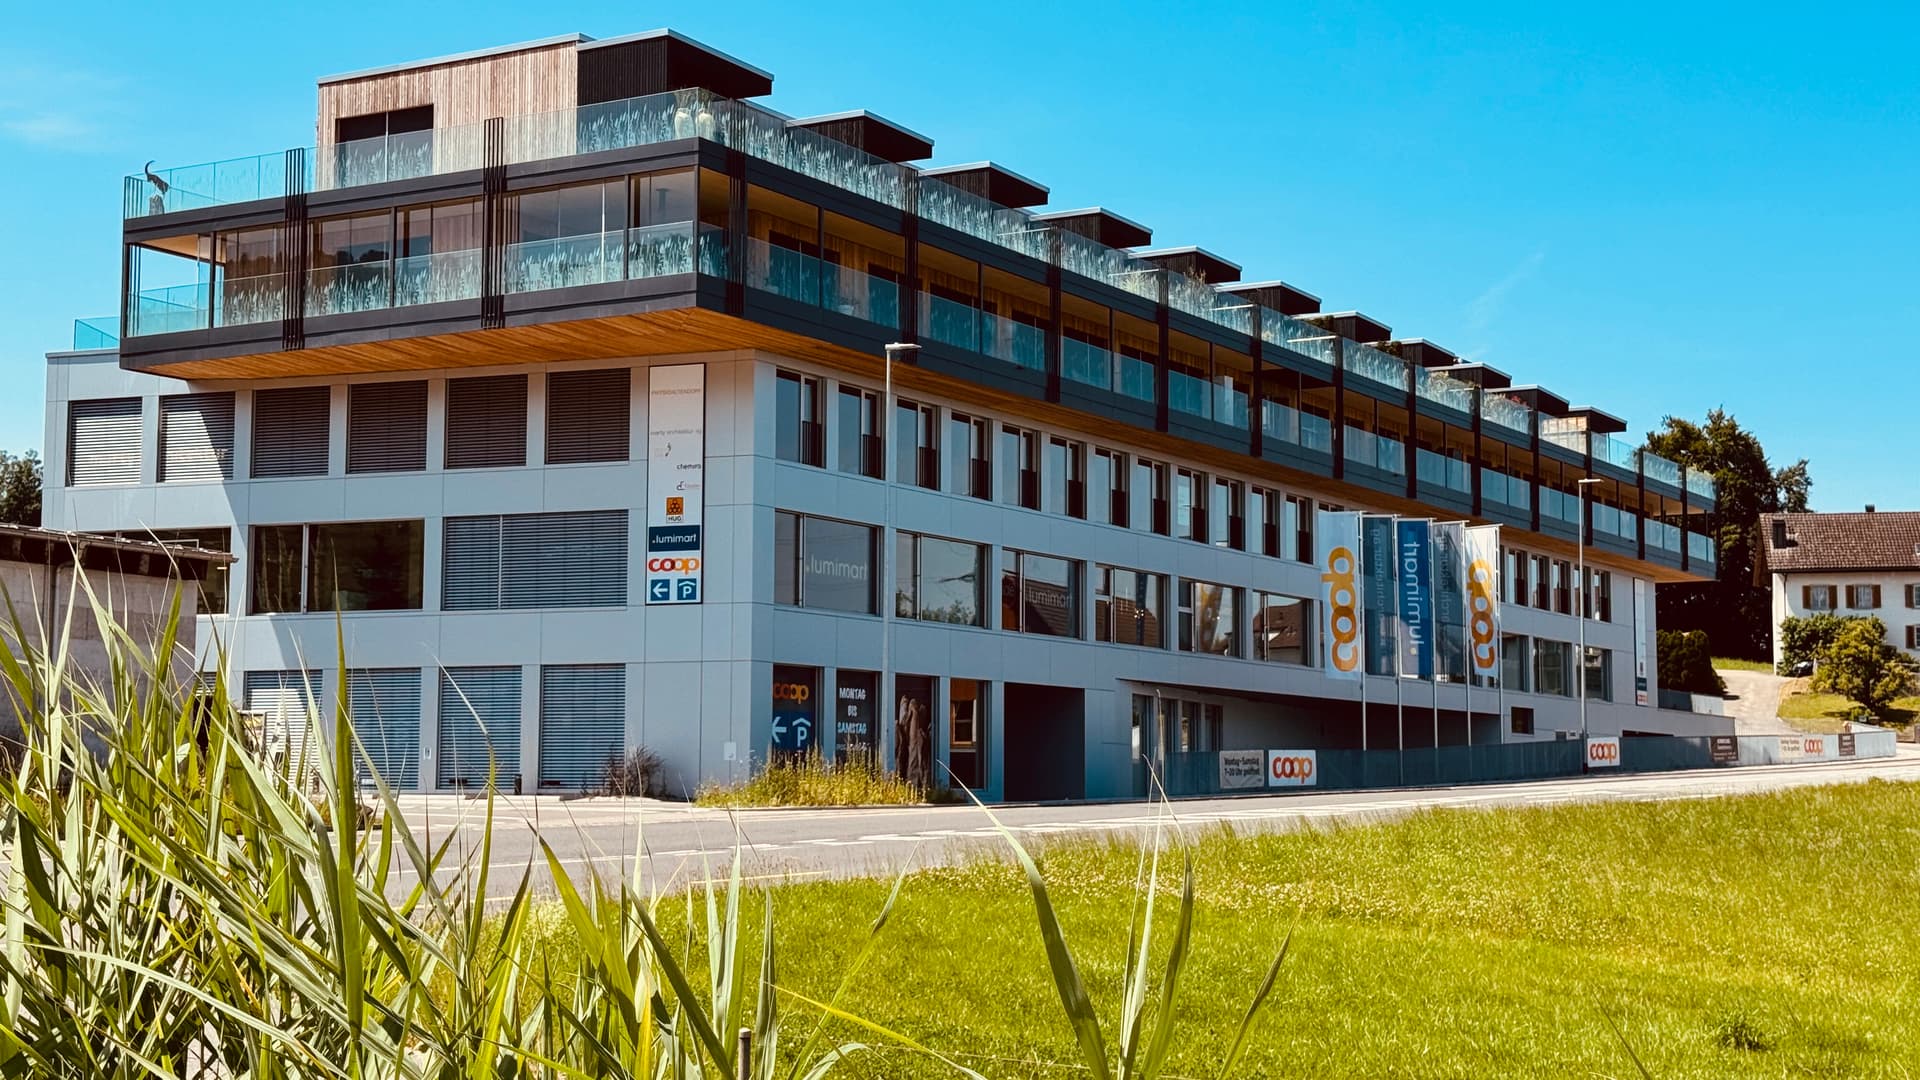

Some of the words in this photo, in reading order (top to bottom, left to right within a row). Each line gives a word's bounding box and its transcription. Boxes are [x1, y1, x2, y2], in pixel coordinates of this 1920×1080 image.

[648, 558, 700, 575] coop
[1321, 546, 1358, 672] coop
[1466, 559, 1495, 669] coop
[773, 683, 809, 705] coop
[839, 687, 866, 700] MONTAG
[1590, 743, 1617, 764] coop
[1272, 756, 1313, 785] coop
